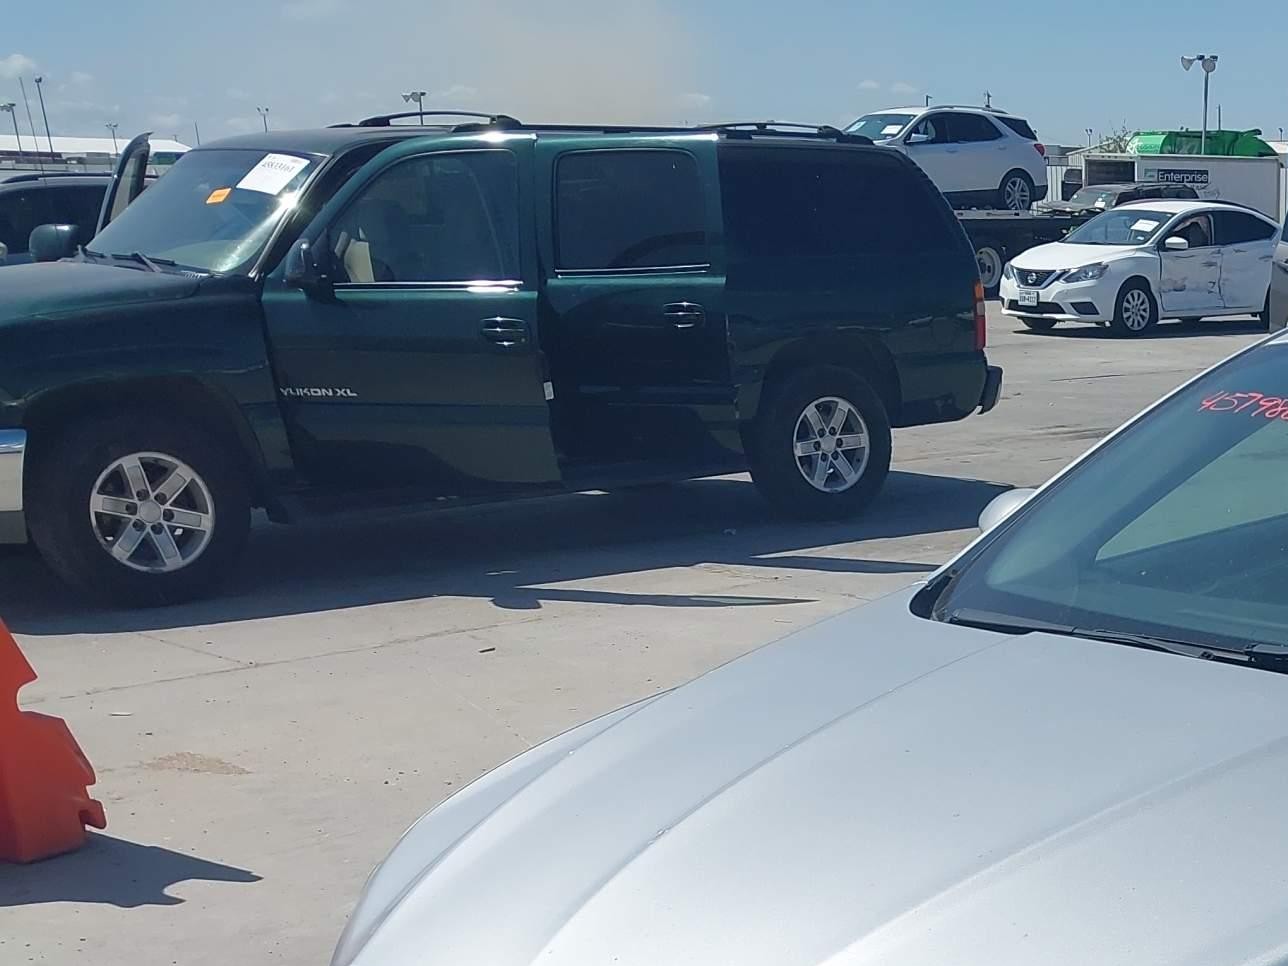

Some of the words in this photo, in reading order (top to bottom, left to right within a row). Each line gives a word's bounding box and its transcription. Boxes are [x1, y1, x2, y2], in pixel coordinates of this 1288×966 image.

[1158, 171, 1208, 183] Enterprise
[279, 387, 333, 396] YUKON
[335, 388, 358, 397] XL
